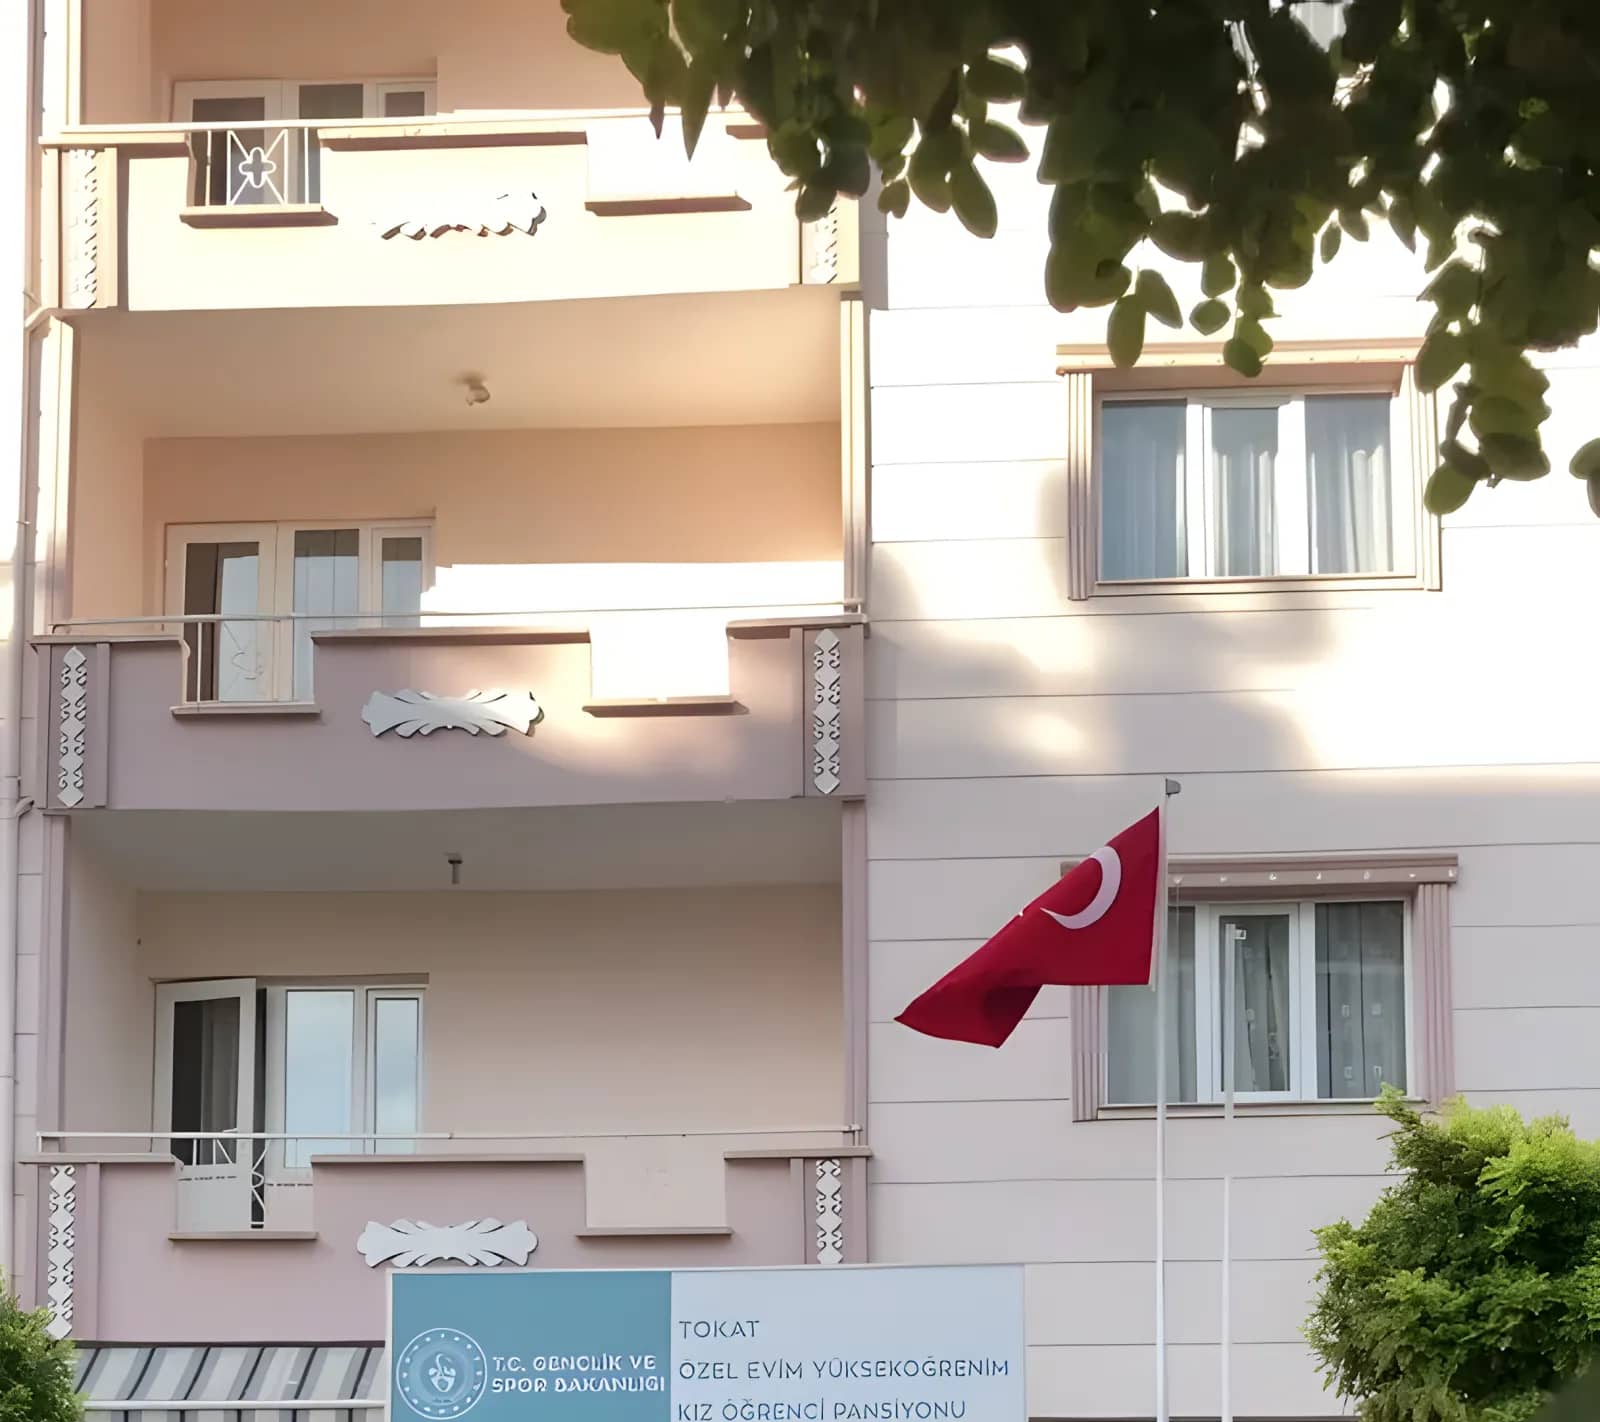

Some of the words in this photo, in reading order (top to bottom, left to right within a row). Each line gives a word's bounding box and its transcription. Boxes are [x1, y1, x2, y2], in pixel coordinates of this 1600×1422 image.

[679, 1320, 760, 1338] TOKAT
[629, 1355, 656, 1370] VE
[679, 1358, 738, 1379] ÖZEL
[748, 1358, 802, 1379] EVİM
[678, 1403, 713, 1421] KIZ
[722, 1398, 824, 1421] ÖĞRENCİ
[834, 1398, 966, 1420] PANSİYONU
